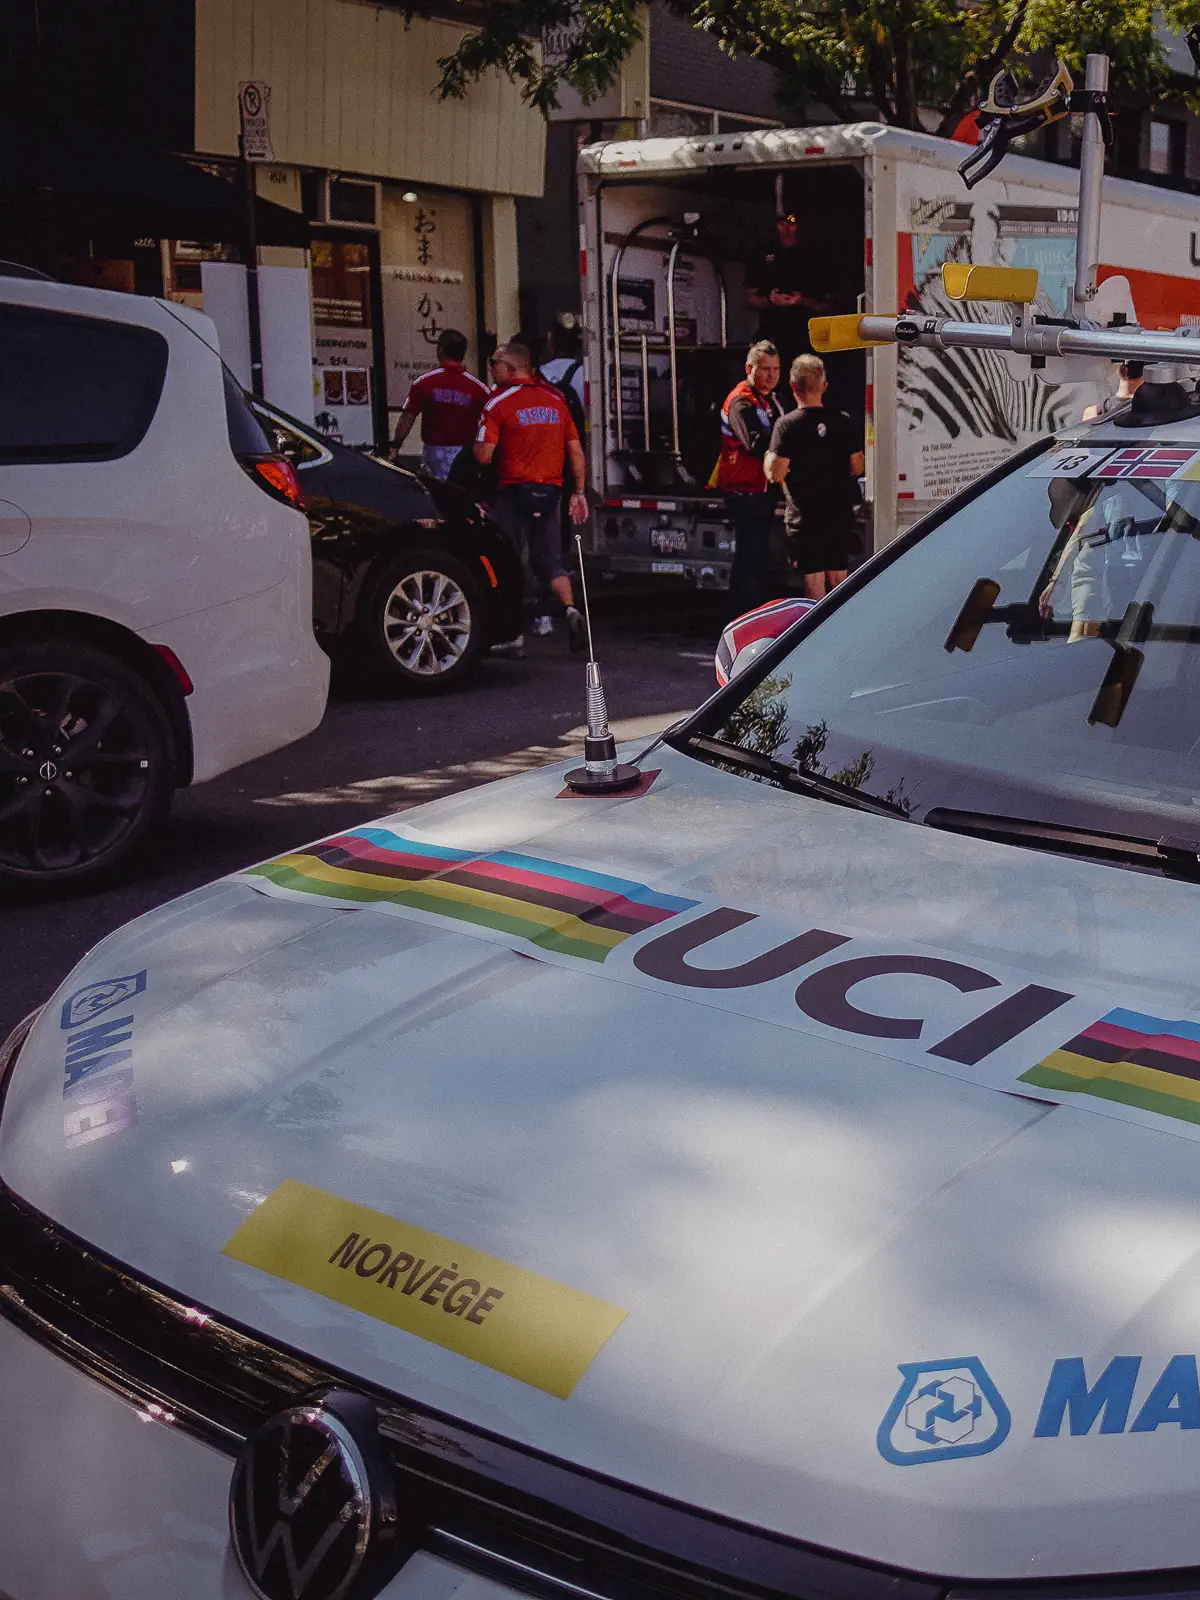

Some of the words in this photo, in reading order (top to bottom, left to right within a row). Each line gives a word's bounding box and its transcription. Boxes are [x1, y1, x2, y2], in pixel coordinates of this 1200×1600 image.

[1052, 455, 1089, 471] 13
[633, 907, 1075, 1065] UCI
[63, 1015, 138, 1150] MAPEI
[327, 1231, 505, 1325] NORVÈGE
